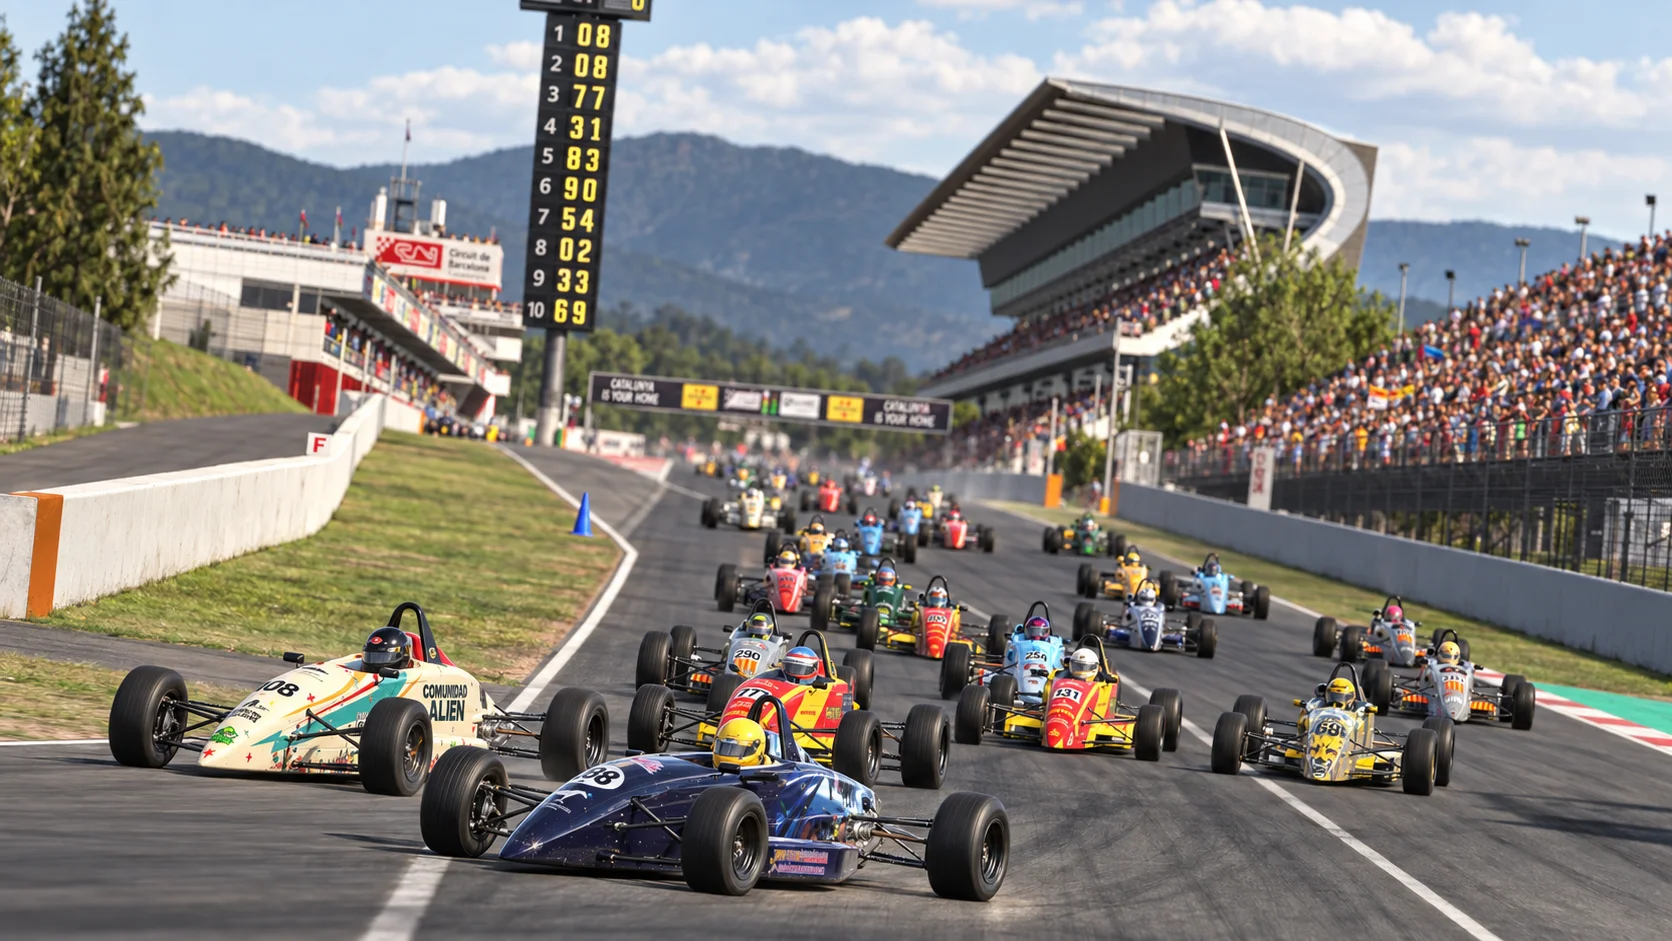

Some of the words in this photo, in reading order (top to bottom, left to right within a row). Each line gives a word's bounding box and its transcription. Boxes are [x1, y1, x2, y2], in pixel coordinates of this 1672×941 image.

[554, 25, 564, 42] 1
[577, 22, 610, 48] 08
[550, 55, 562, 72] 2
[574, 53, 608, 79] 08
[547, 85, 560, 103] 3
[573, 84, 606, 110] 77
[543, 117, 557, 135] 4
[569, 115, 601, 141] 31
[541, 147, 554, 164] 5
[566, 146, 600, 172] 83
[539, 177, 552, 194] 6
[564, 176, 597, 202] 90
[538, 208, 550, 225] 7
[561, 206, 594, 233] 54
[449, 248, 477, 260] Circuit
[479, 252, 491, 262] de
[535, 238, 547, 256] 8
[559, 237, 592, 263] 02
[533, 269, 545, 287] 9
[557, 268, 590, 294] 33
[527, 301, 545, 318] 10
[554, 298, 587, 325] 69
[612, 390, 633, 403] YOUR
[313, 437, 327, 453] F
[735, 649, 761, 661] 290
[423, 684, 468, 699] COMUNIDAD
[1056, 688, 1079, 700] 131
[429, 700, 465, 722] ALIEN
